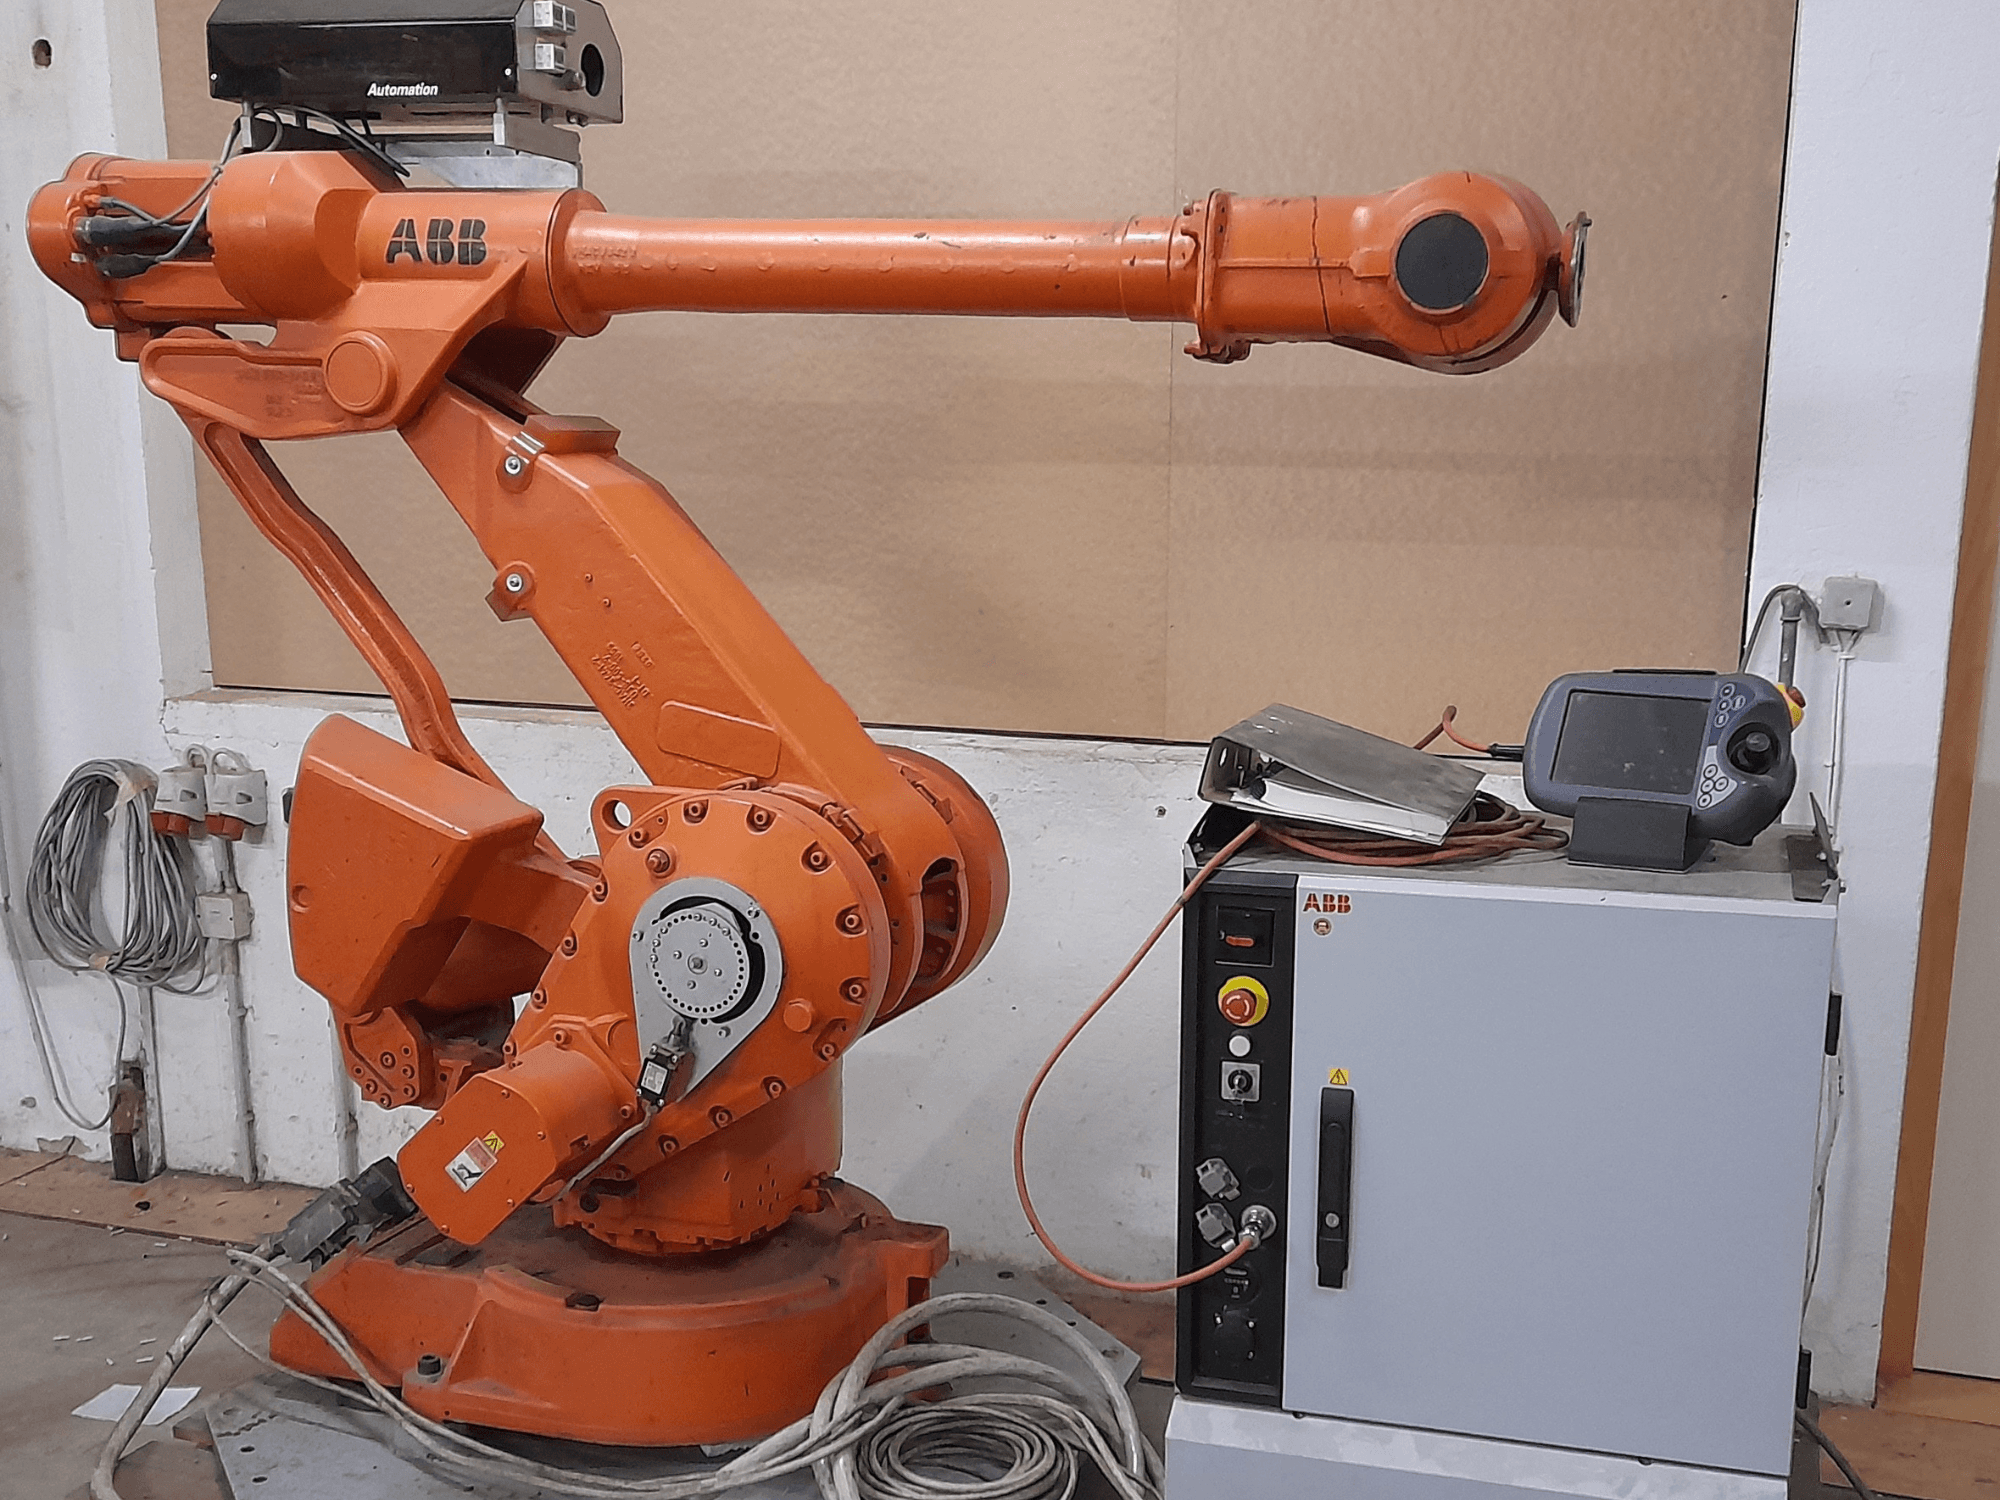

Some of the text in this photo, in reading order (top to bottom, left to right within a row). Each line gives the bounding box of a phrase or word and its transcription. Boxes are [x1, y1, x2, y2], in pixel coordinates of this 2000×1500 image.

[367, 82, 439, 97] Automation
[386, 218, 487, 265] ABB
[1303, 893, 1351, 913] ABB
